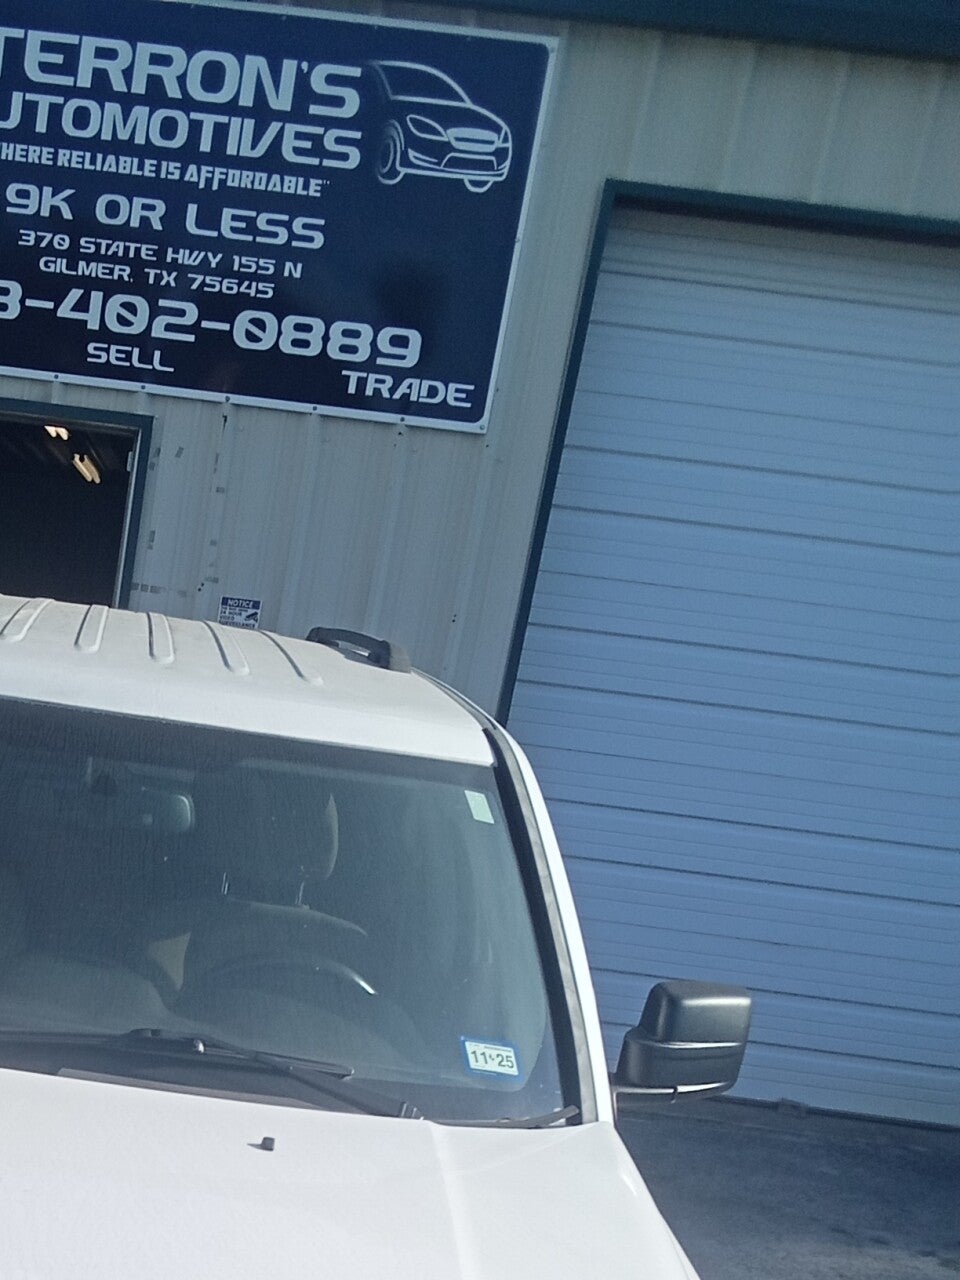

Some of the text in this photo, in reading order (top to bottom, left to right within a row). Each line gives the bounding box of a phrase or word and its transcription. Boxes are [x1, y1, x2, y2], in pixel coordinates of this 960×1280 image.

[57, 148, 158, 178] RELIABLE
[159, 160, 182, 180] IS
[5, 182, 326, 250] 9K OR LESS
[17, 229, 303, 279] 370 STATE HWY 155 N
[144, 268, 178, 287] TX
[187, 273, 275, 299] 75645
[86, 342, 175, 372] SELL
[341, 369, 475, 408] TRADE
[227, 599, 253, 608] NOTICE
